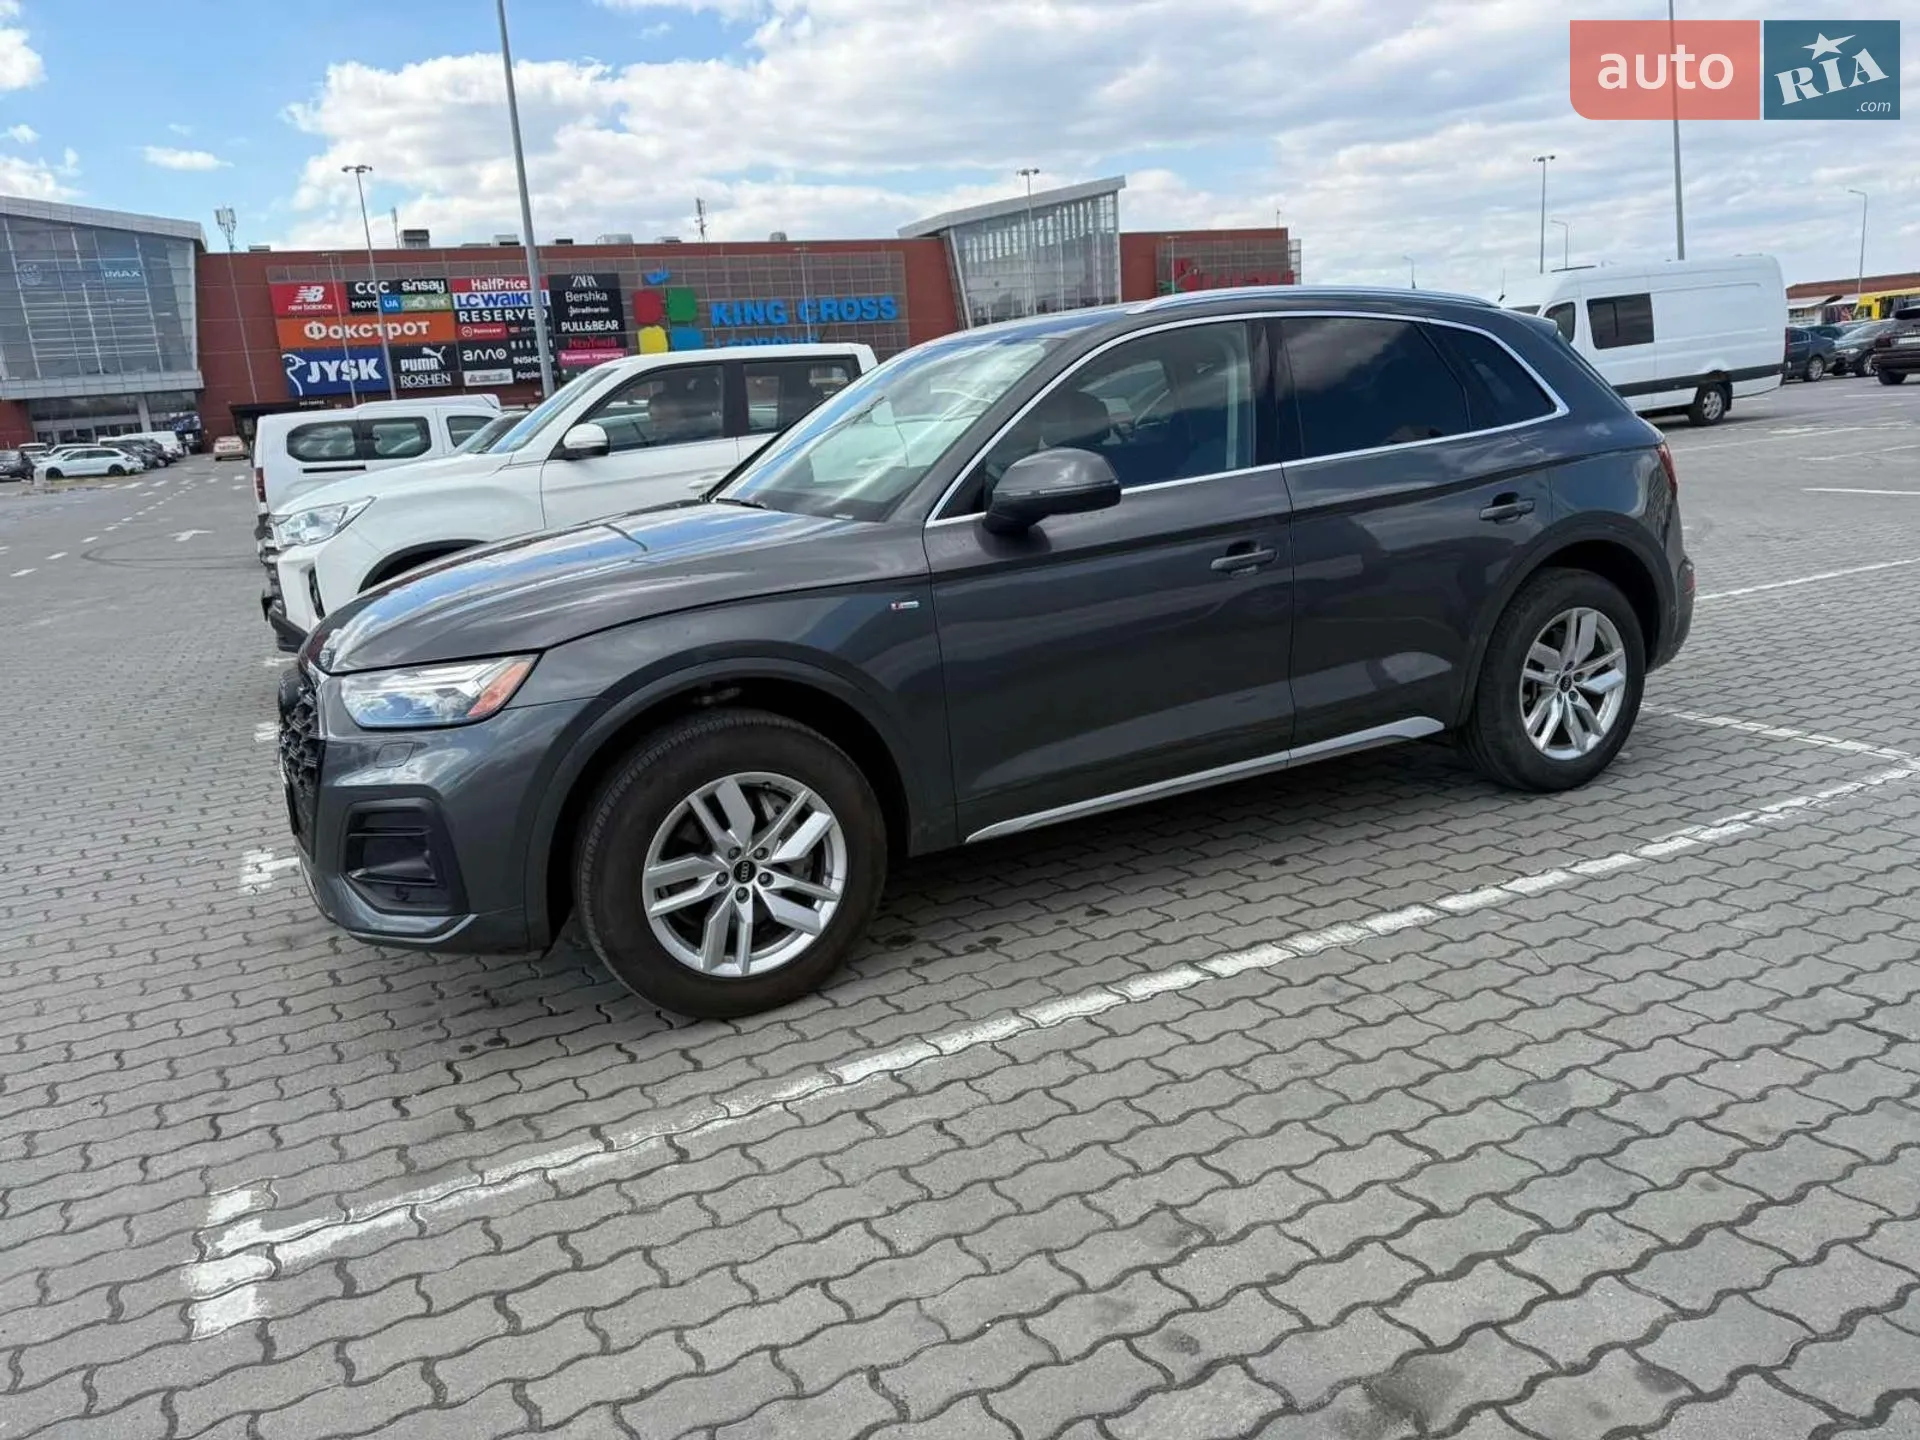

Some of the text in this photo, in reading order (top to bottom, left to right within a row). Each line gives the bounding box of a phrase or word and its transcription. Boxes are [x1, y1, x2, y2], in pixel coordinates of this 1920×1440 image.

[105, 270, 141, 278] IMAX
[355, 281, 390, 294] CCC
[401, 278, 446, 294] sinsay
[471, 278, 528, 291] HalfPrice
[565, 290, 608, 303] Bershka
[710, 296, 897, 327] KING CROSS
[303, 320, 431, 341] Фокстрот
[561, 319, 620, 333] PULL&BEAR
[307, 357, 382, 384] JYSK
[400, 357, 440, 373] PUMA
[399, 373, 451, 388] ROSHEN
